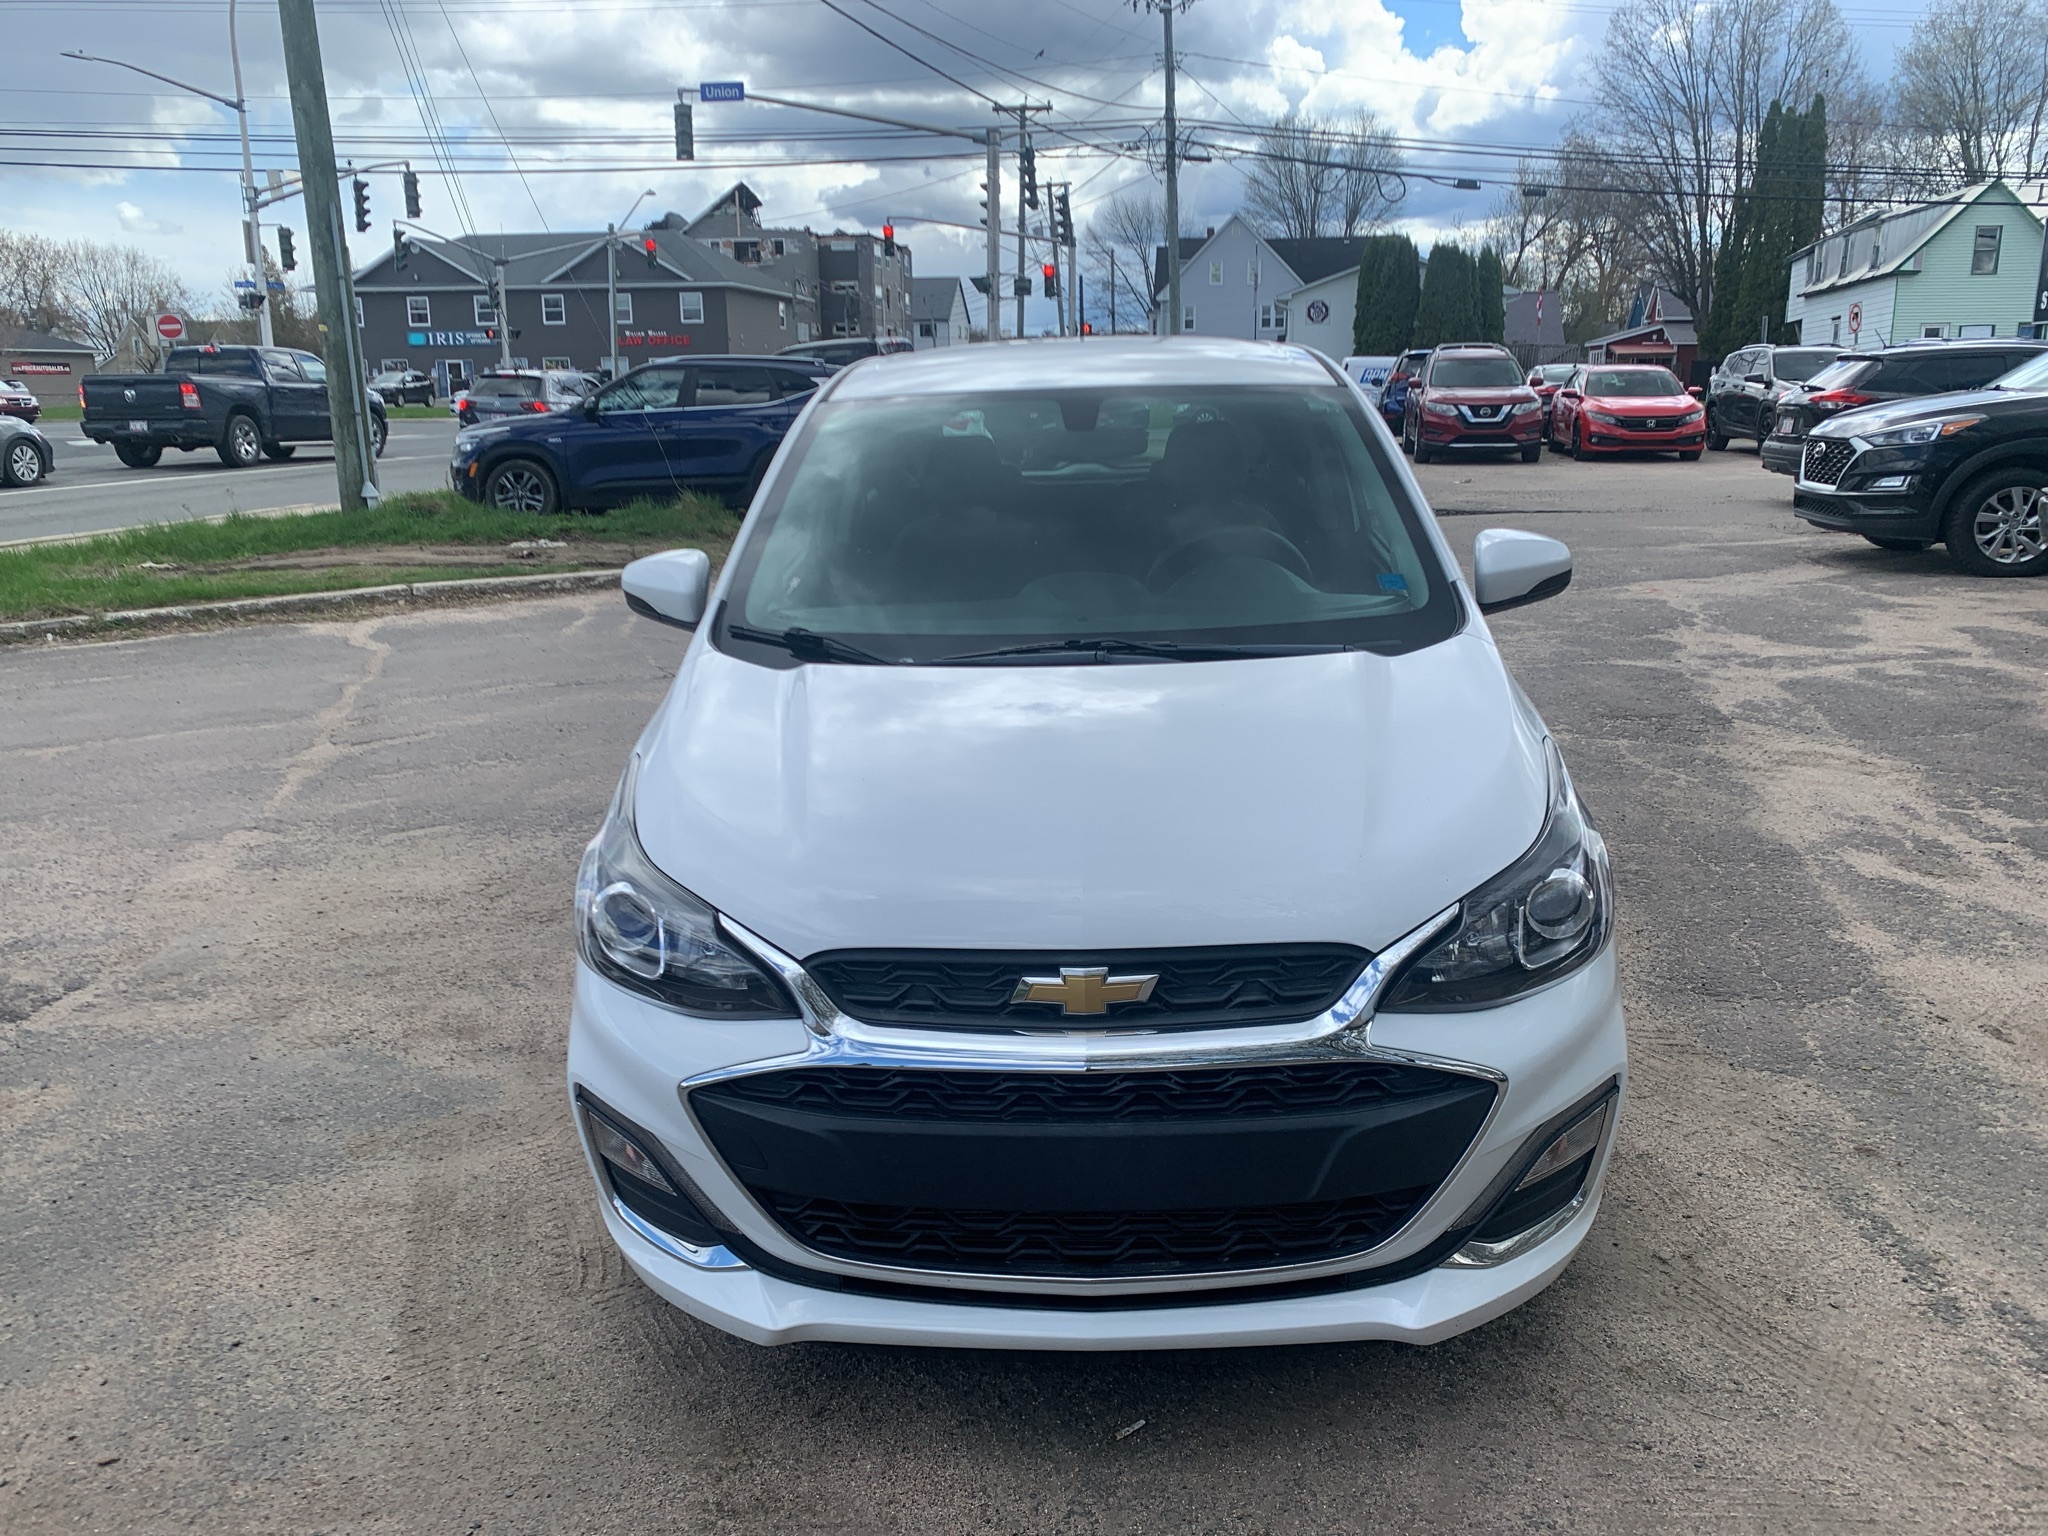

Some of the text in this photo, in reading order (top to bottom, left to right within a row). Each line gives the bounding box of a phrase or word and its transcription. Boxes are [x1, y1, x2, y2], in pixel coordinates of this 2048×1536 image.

[705, 85, 739, 98] Union
[428, 331, 465, 346] IRIS
[617, 335, 690, 347] LAW OFFICE
